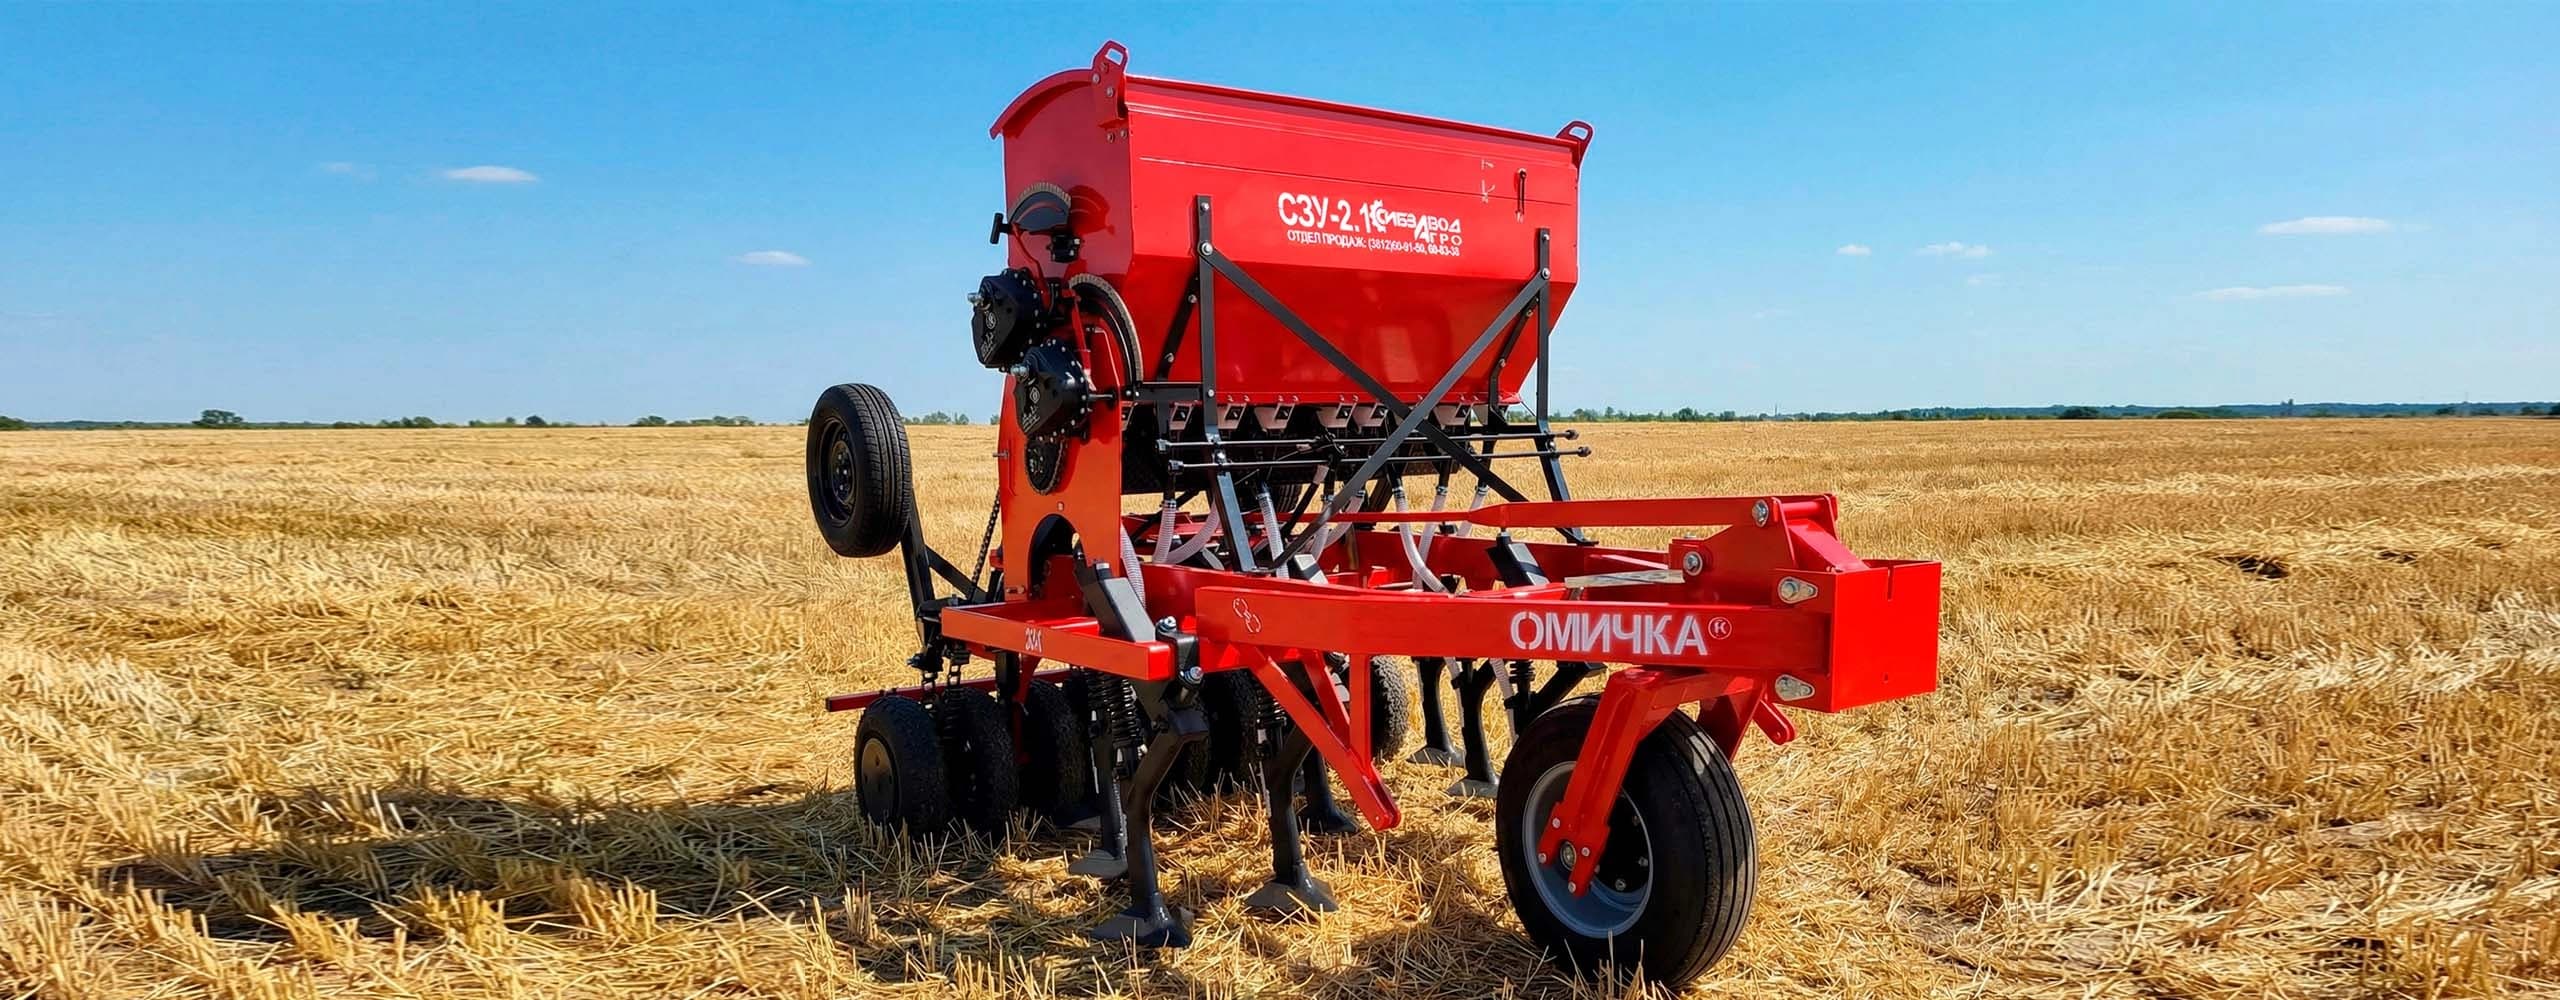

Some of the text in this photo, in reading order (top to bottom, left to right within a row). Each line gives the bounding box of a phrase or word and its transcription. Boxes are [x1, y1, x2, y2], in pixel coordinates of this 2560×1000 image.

[1278, 192, 1371, 233] СЗУ-2.1
[1287, 229, 1320, 244] ОТДЕЛ
[1322, 232, 1366, 248] ПРОДАЖ:
[1510, 611, 1708, 655] ОМИЧКА
